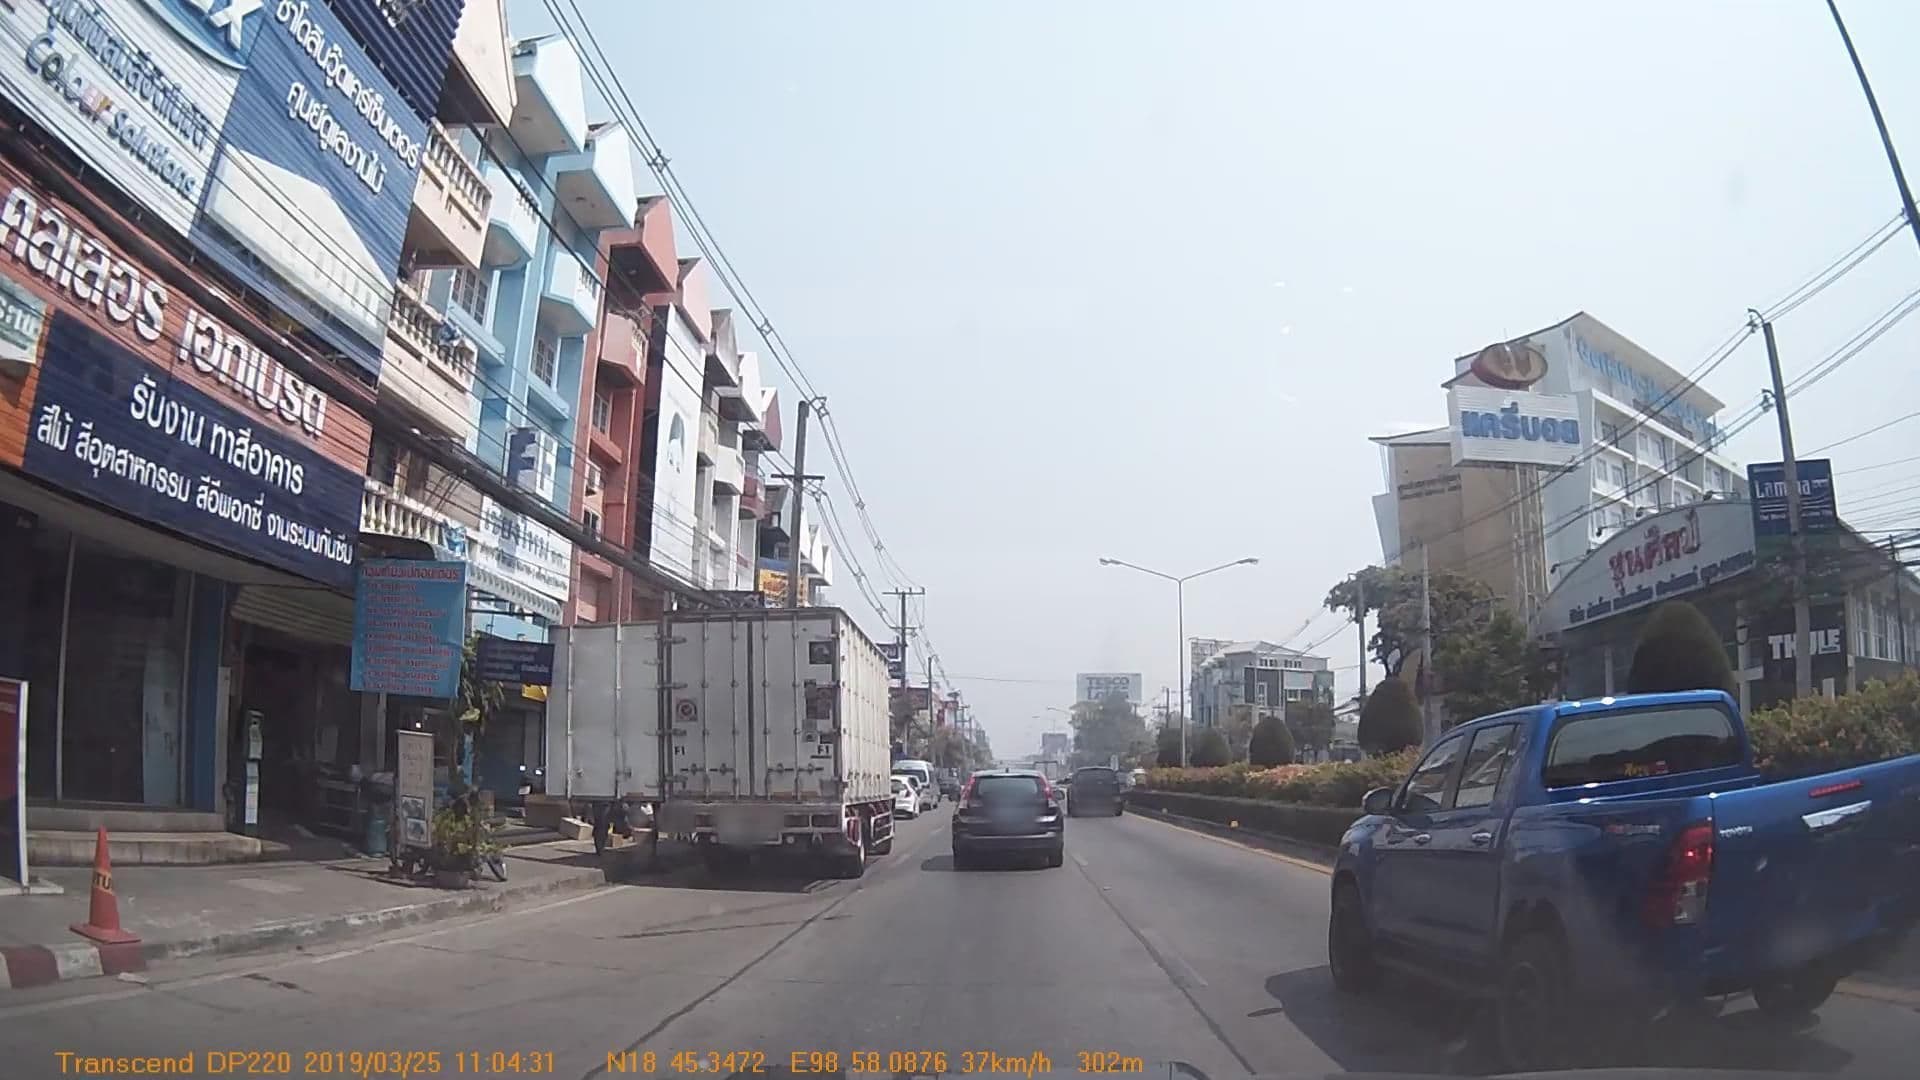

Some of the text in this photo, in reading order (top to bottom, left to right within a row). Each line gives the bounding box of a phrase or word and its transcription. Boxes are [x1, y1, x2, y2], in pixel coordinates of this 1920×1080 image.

[26, 32, 196, 196] Colour Solutions
[36, 404, 74, 451] สีไม้
[74, 421, 191, 503] สีอุตสาหกรรม
[130, 374, 305, 495] รับงาน ทาสีอาคาร
